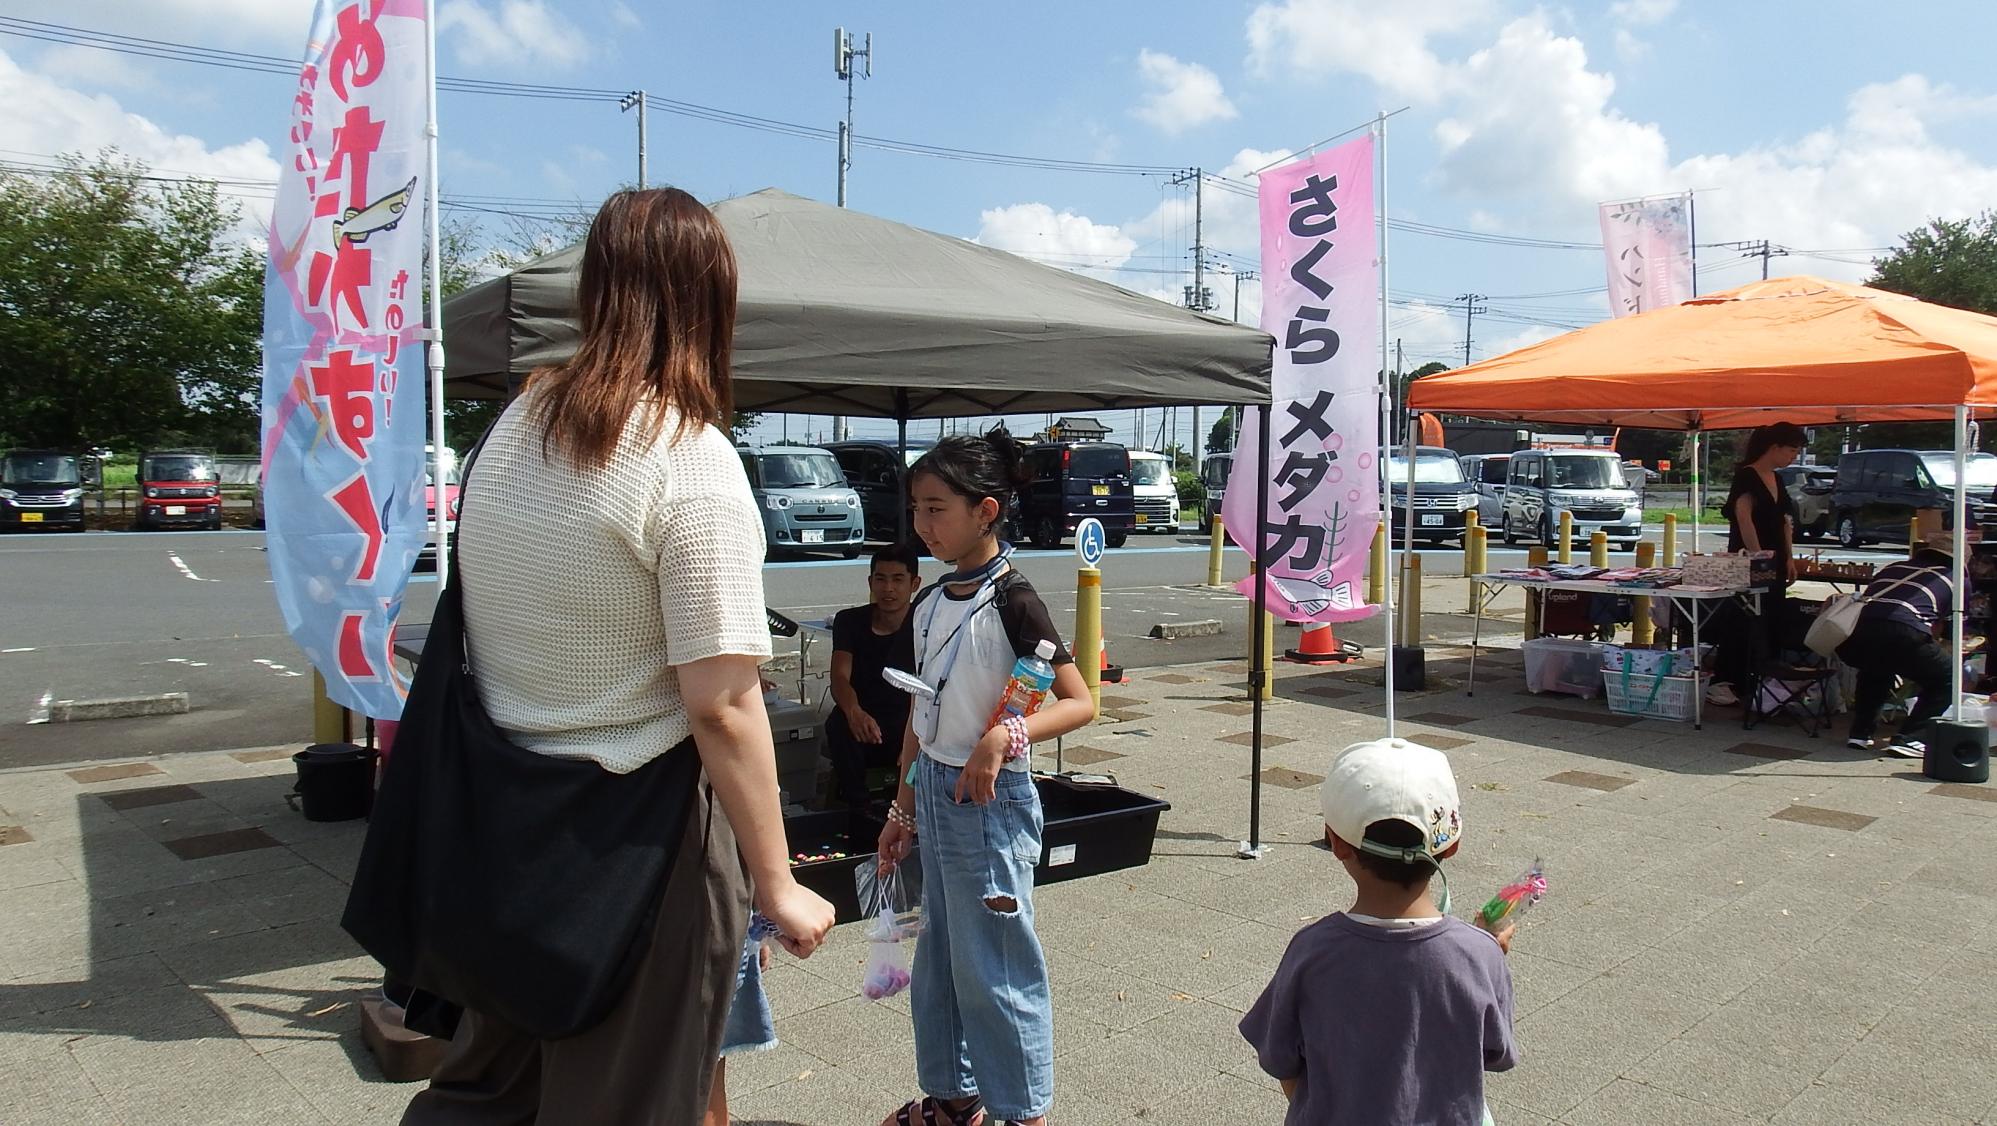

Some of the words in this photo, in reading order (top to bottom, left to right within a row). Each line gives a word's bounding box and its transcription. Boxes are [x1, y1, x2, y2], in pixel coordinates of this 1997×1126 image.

[1285, 174, 1340, 365] さくら
[1265, 390, 1338, 571] メダカ
